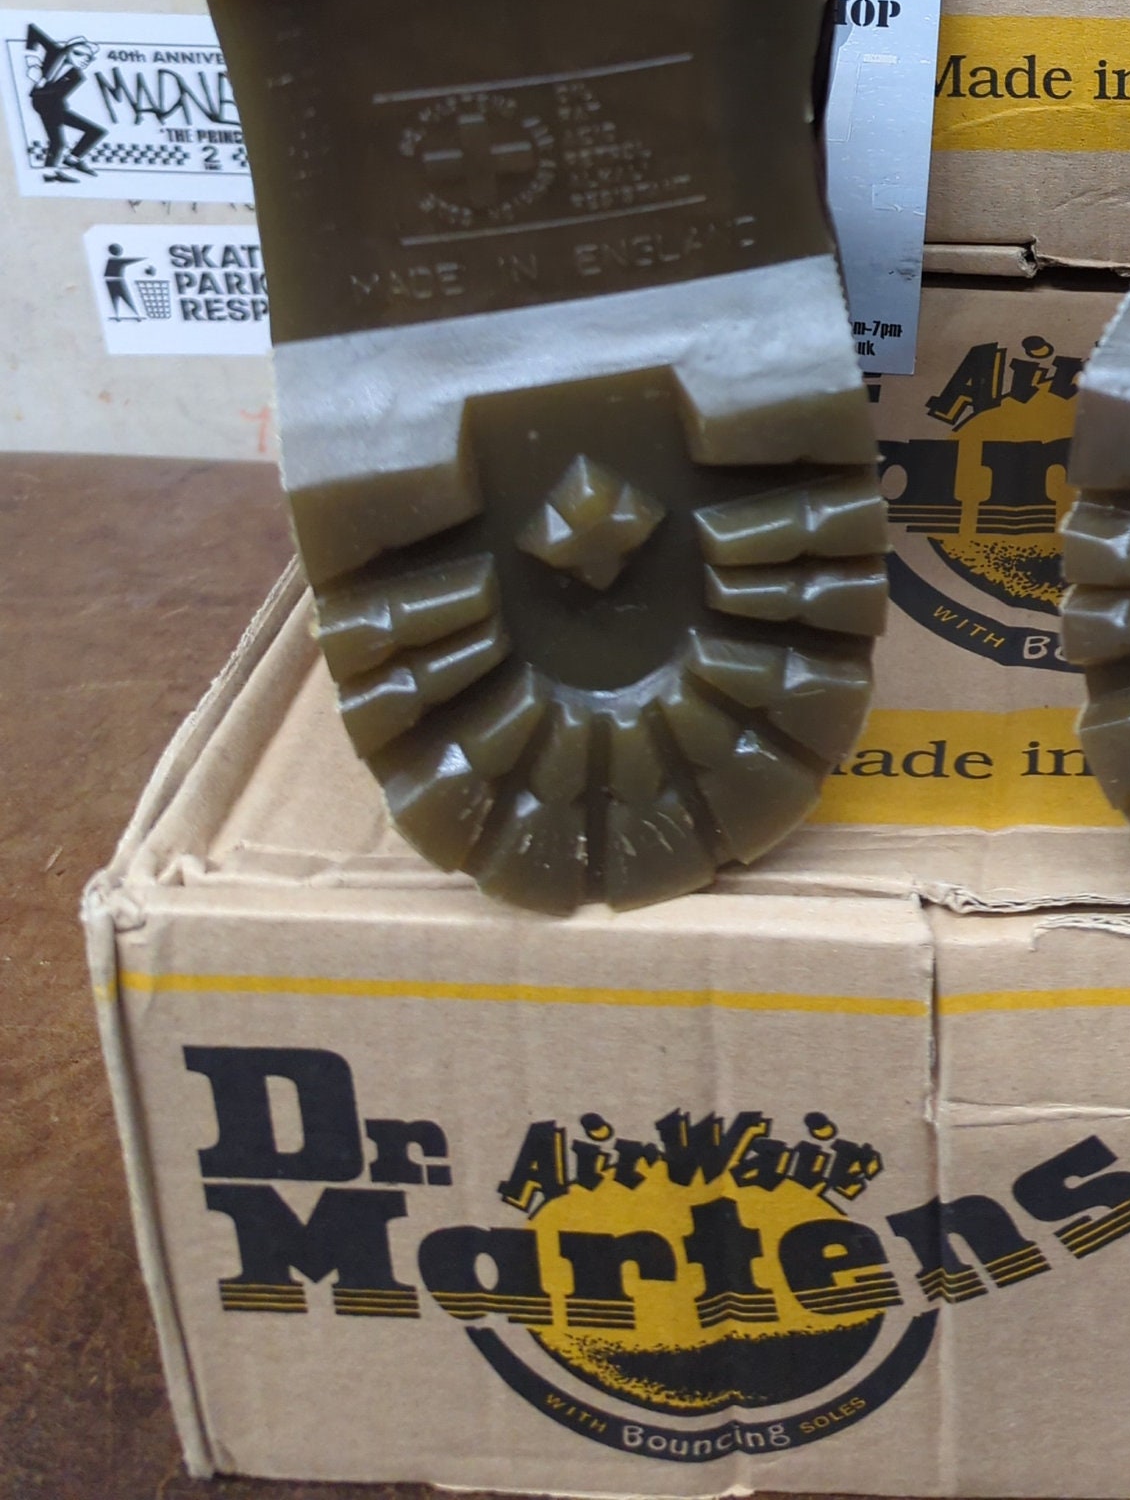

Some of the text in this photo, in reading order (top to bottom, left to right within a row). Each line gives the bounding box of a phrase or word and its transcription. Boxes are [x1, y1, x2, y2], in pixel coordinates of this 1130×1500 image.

[107, 50, 147, 63] 40th
[932, 605, 1006, 649] WITH
[830, 739, 1097, 780] ade in
[182, 1044, 453, 1186] Dr.
[498, 1106, 884, 1220] AirWair
[545, 1393, 867, 1457] WITH Bouncing SOLES
